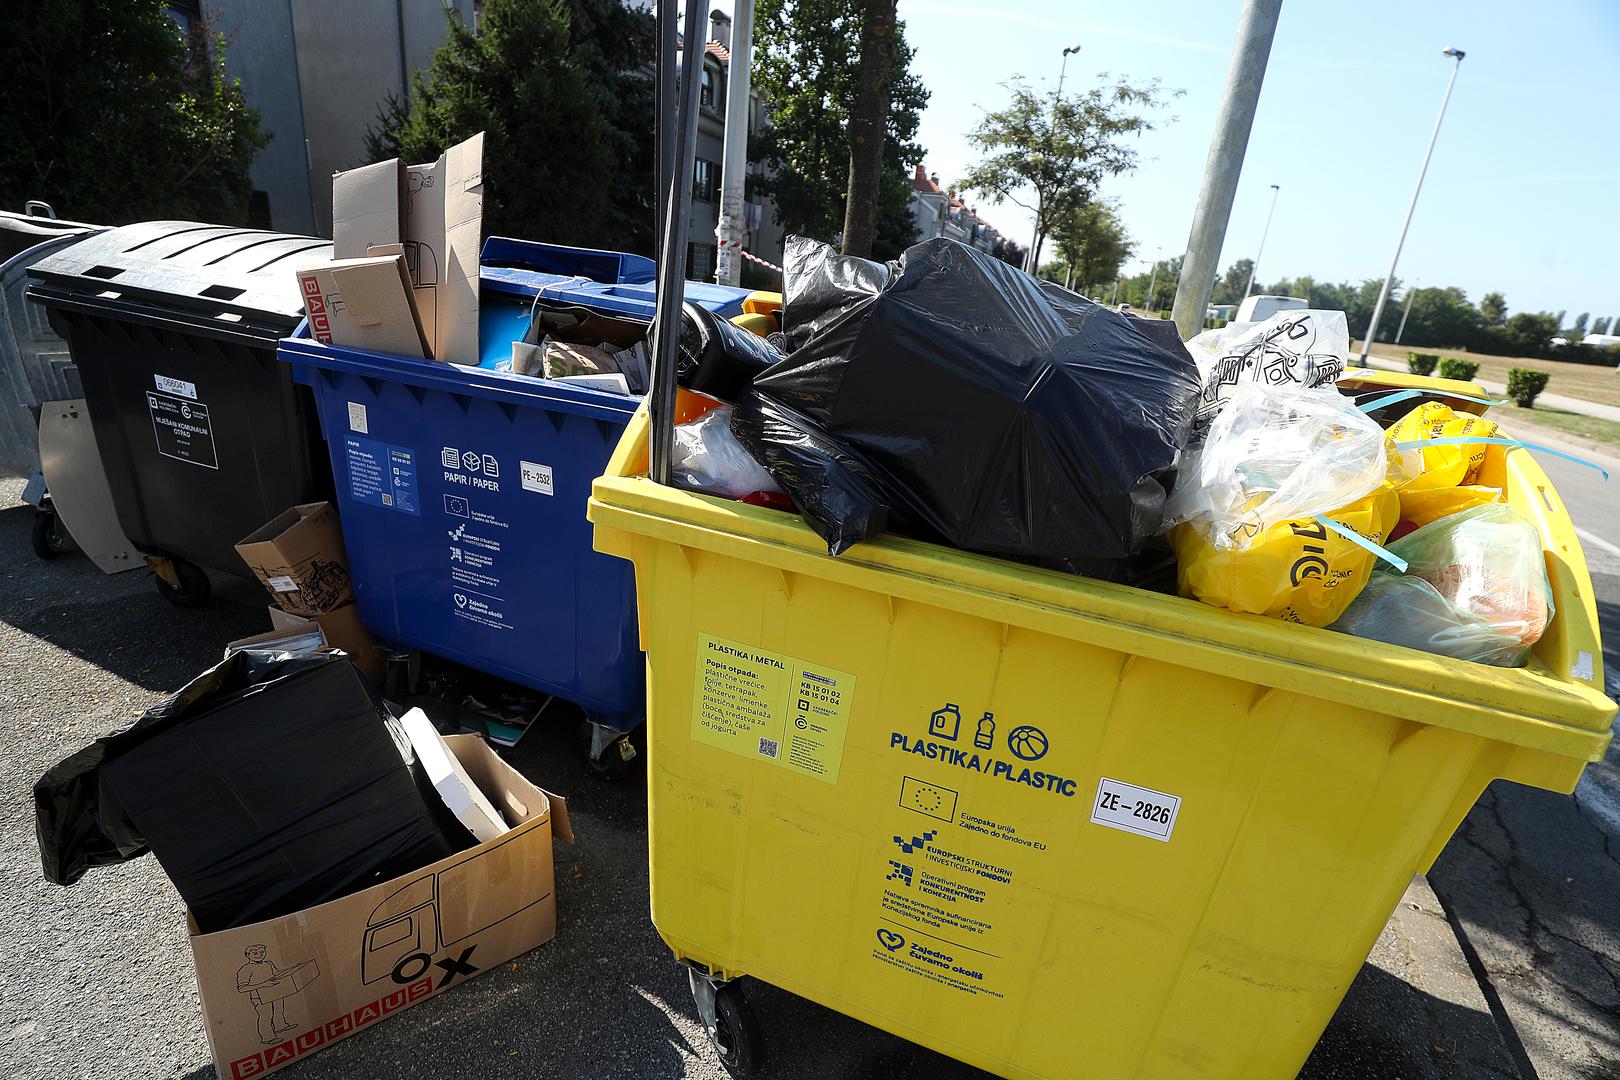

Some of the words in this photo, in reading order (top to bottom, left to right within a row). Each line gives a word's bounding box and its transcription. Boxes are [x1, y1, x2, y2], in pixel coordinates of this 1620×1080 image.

[444, 471, 467, 484] PAPIR
[468, 477, 472, 485] /
[473, 477, 500, 492] PAPER
[708, 642, 749, 660] PLASTIKA
[755, 656, 785, 669] METAL
[705, 668, 737, 683] plastične
[739, 679, 766, 691] vrećice,
[706, 659, 727, 670] Popis
[728, 666, 759, 679] otpada:
[704, 686, 738, 700] konzerve,
[739, 696, 770, 710] limenke,
[725, 682, 758, 698] tetrapak,
[800, 689, 810, 697] KB
[820, 694, 828, 702] 01
[830, 697, 840, 705] 04
[821, 687, 829, 695] 01
[831, 690, 840, 698] 02
[703, 695, 734, 710] plastična
[736, 704, 771, 719] ambalaža
[725, 710, 756, 724] sredstva
[702, 710, 733, 727] čišćenje),
[735, 721, 751, 731] čaše
[711, 722, 737, 736] jogurta
[890, 732, 981, 773] PLASTIKA
[984, 759, 992, 774] /
[993, 760, 1077, 797] PLASTIC
[960, 813, 996, 829] Europska
[997, 824, 1016, 834] unija
[959, 821, 989, 835] Zajedno
[991, 830, 1001, 838] do
[1001, 833, 1032, 847] fondova
[1034, 842, 1046, 850] EU
[927, 846, 965, 863] EUROPSKI
[966, 858, 1013, 876] STRUKTURNI
[922, 871, 956, 887] Operativni
[958, 883, 986, 897] program
[976, 870, 1011, 884] FONDOVI
[920, 879, 984, 903] KONKURENTNOST
[923, 887, 957, 902] KOHEZIJA
[882, 896, 890, 904] je
[890, 898, 925, 916] sredstvima
[927, 912, 959, 926] Europske
[960, 922, 976, 933] unije
[882, 902, 920, 924] Kohezijskog
[922, 917, 941, 928] fonda
[884, 890, 910, 902] Nabava
[910, 898, 945, 915] spremnika
[946, 911, 992, 930] sufinancirana
[910, 942, 954, 963] Zajedno
[909, 950, 950, 969] čuvamo
[952, 965, 984, 980] okoliš
[237, 979, 431, 1079] BAUHAUS
